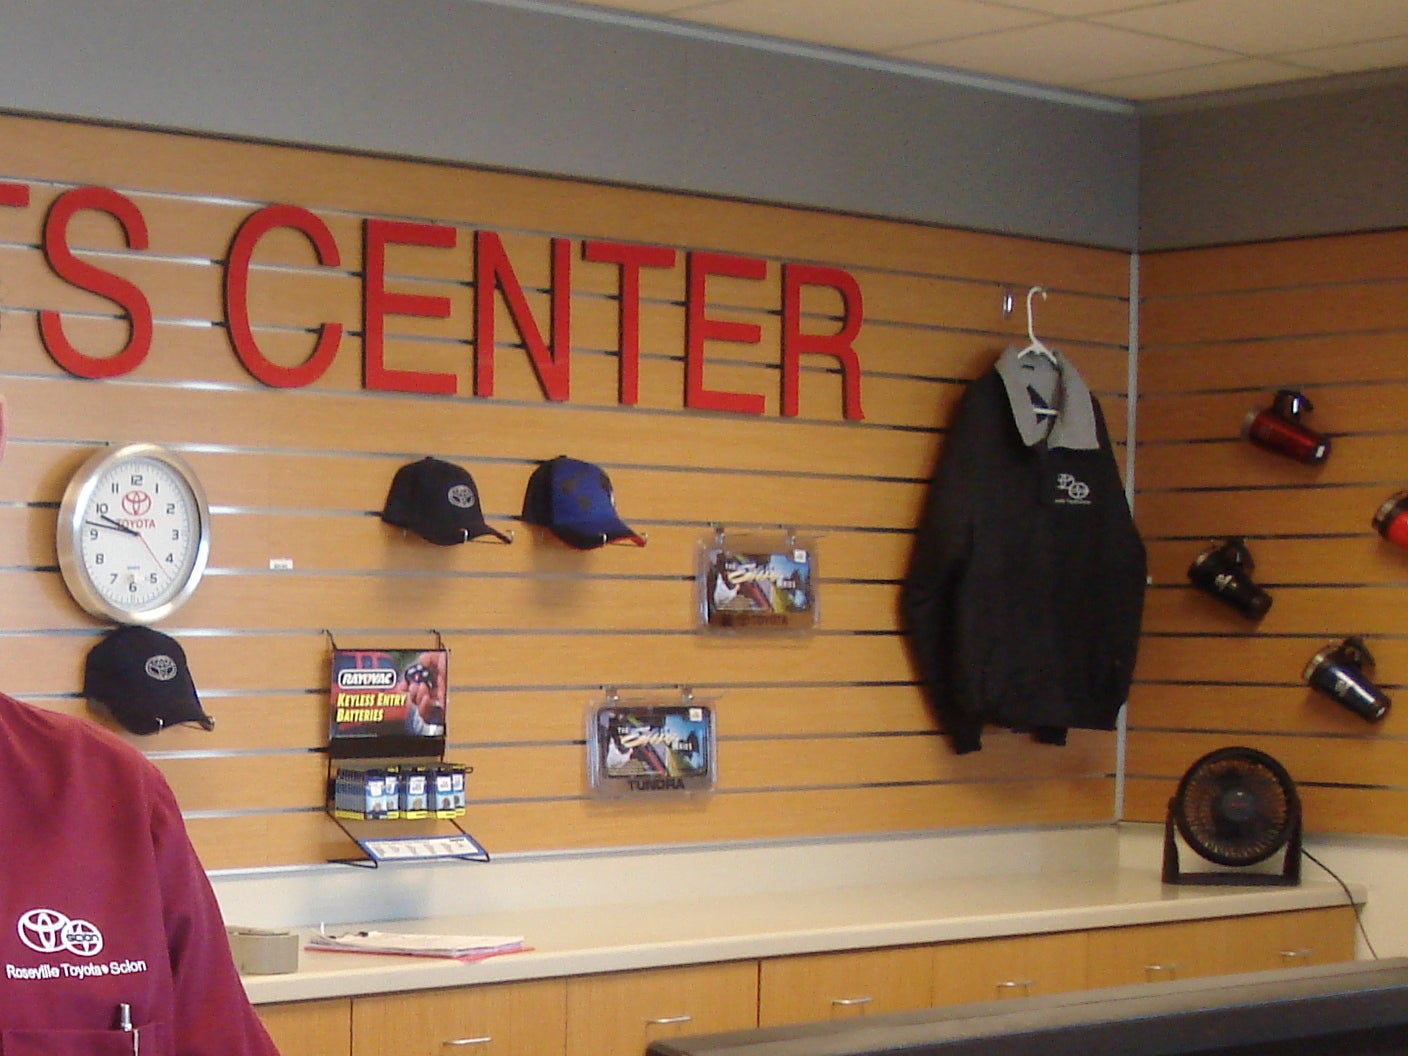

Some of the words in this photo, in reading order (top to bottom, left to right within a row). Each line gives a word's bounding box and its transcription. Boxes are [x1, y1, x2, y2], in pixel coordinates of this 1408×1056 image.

[223, 203, 865, 421] CENTER
[131, 475, 143, 486] 12
[111, 483, 119, 494] 11
[96, 503, 108, 514] 10
[166, 503, 175, 514] 2
[116, 518, 156, 530] TOYOTA
[90, 529, 98, 540] 9
[172, 530, 179, 541] 3
[95, 554, 104, 564] 8
[165, 553, 173, 563] 4
[110, 573, 118, 584] 7
[150, 573, 158, 584] 5
[129, 582, 137, 592] 6
[342, 673, 392, 685] RAYOVAC
[337, 693, 376, 707] KEYLESS
[377, 692, 408, 706] ENTRY
[336, 708, 384, 722] BATTERIES
[628, 779, 685, 791] TUNDRA
[5, 963, 60, 980] Roseville
